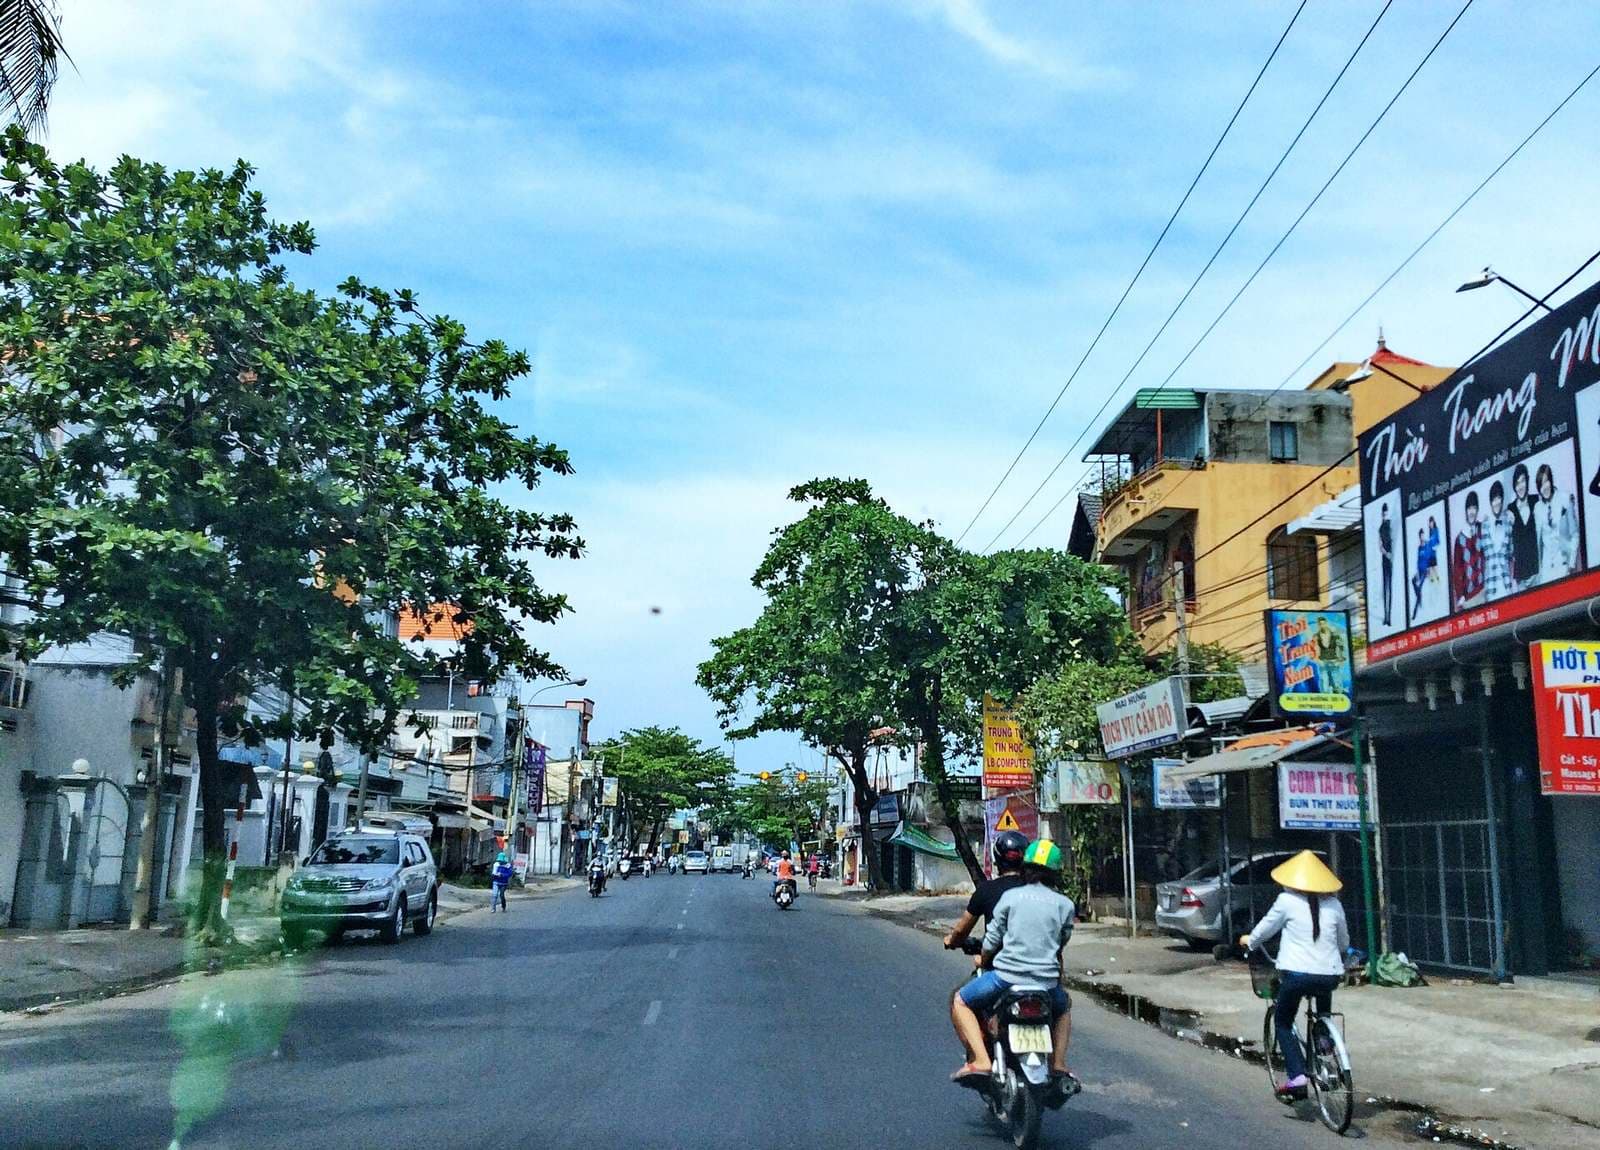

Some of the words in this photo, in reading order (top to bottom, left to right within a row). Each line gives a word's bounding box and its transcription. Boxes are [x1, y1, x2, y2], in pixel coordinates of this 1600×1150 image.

[1366, 422, 1429, 498] Thời
[1443, 372, 1538, 455] Trang
[1552, 646, 1587, 670] HỚT
[988, 727, 1012, 738] TRUNG
[1102, 720, 1122, 748] DỊCH
[1121, 714, 1136, 743] VỤ
[994, 742, 1006, 752] TIN
[1560, 768, 1597, 780] Massage
